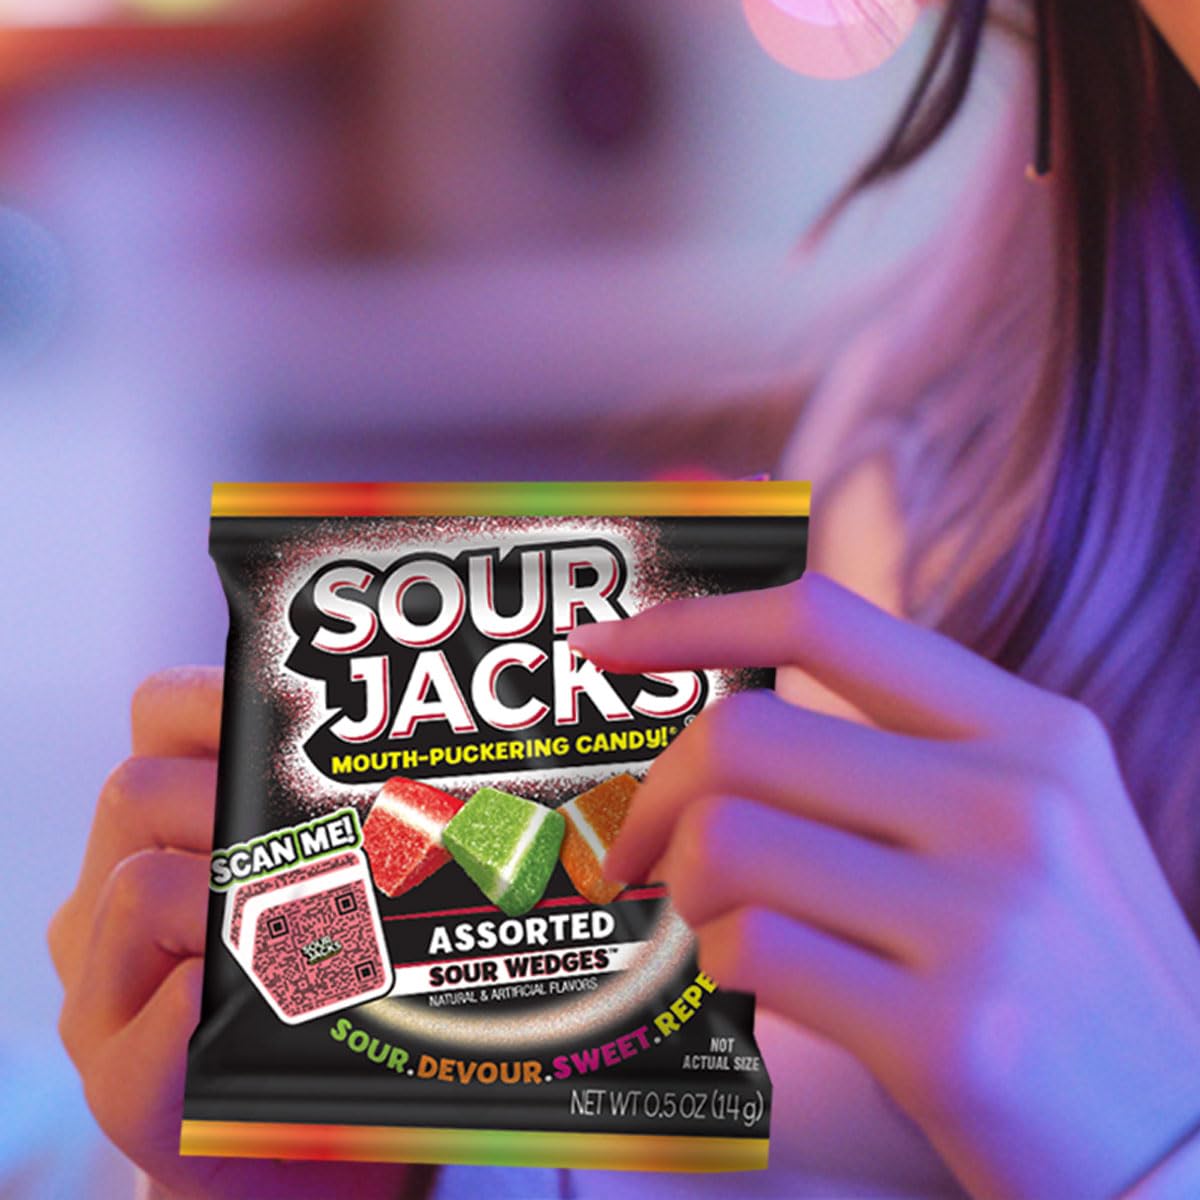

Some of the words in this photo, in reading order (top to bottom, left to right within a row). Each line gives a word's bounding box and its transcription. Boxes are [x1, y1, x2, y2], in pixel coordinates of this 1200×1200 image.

[311, 545, 624, 655] SOUR
[331, 736, 569, 775] MOUTH-PUCKERING
[211, 836, 297, 885] SCAN
[299, 815, 357, 857] ME!
[428, 910, 615, 955] ASSORTED
[429, 961, 499, 988] SOUR
[428, 990, 478, 1007] NATURAL
[480, 989, 489, 1002] &
[490, 982, 548, 1001] ARTIFICIAL
[549, 976, 599, 995] FLAVORS
[709, 1036, 736, 1053] NOT
[682, 1055, 730, 1071] ACTUAL
[732, 1056, 760, 1072] SIZE
[570, 1088, 607, 1116] NET
[609, 1090, 642, 1117] WT
[643, 1090, 677, 1119] 0.5
[679, 1092, 708, 1119] OZ
